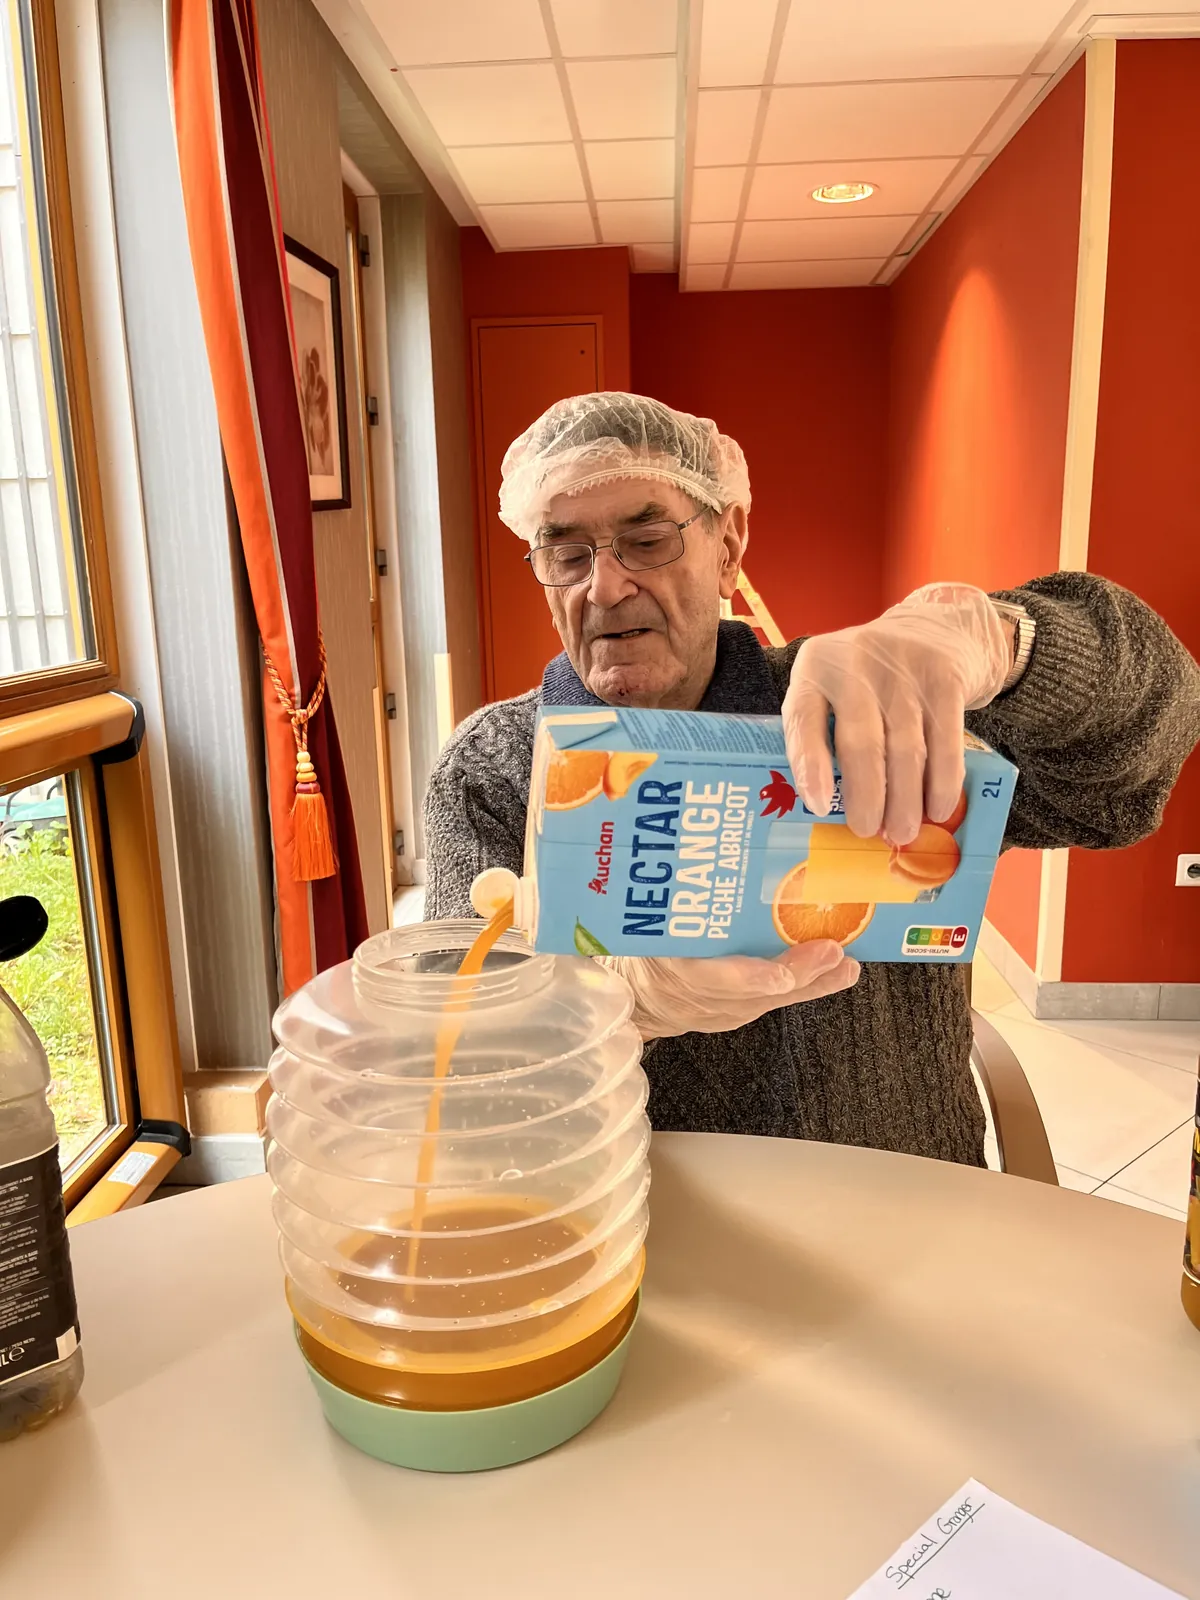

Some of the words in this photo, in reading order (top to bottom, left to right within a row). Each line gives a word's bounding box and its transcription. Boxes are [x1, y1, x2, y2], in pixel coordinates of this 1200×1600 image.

[981, 777, 1002, 798] 2L
[588, 821, 615, 895] Auchan
[622, 780, 683, 936] NECTAR
[668, 780, 725, 938] ORANGE
[718, 782, 750, 871] ABRICOT
[706, 875, 738, 939] PÊCHE
[908, 932, 918, 940] A
[931, 931, 941, 941] C
[953, 933, 966, 942] E
[886, 1533, 938, 1583] Special
